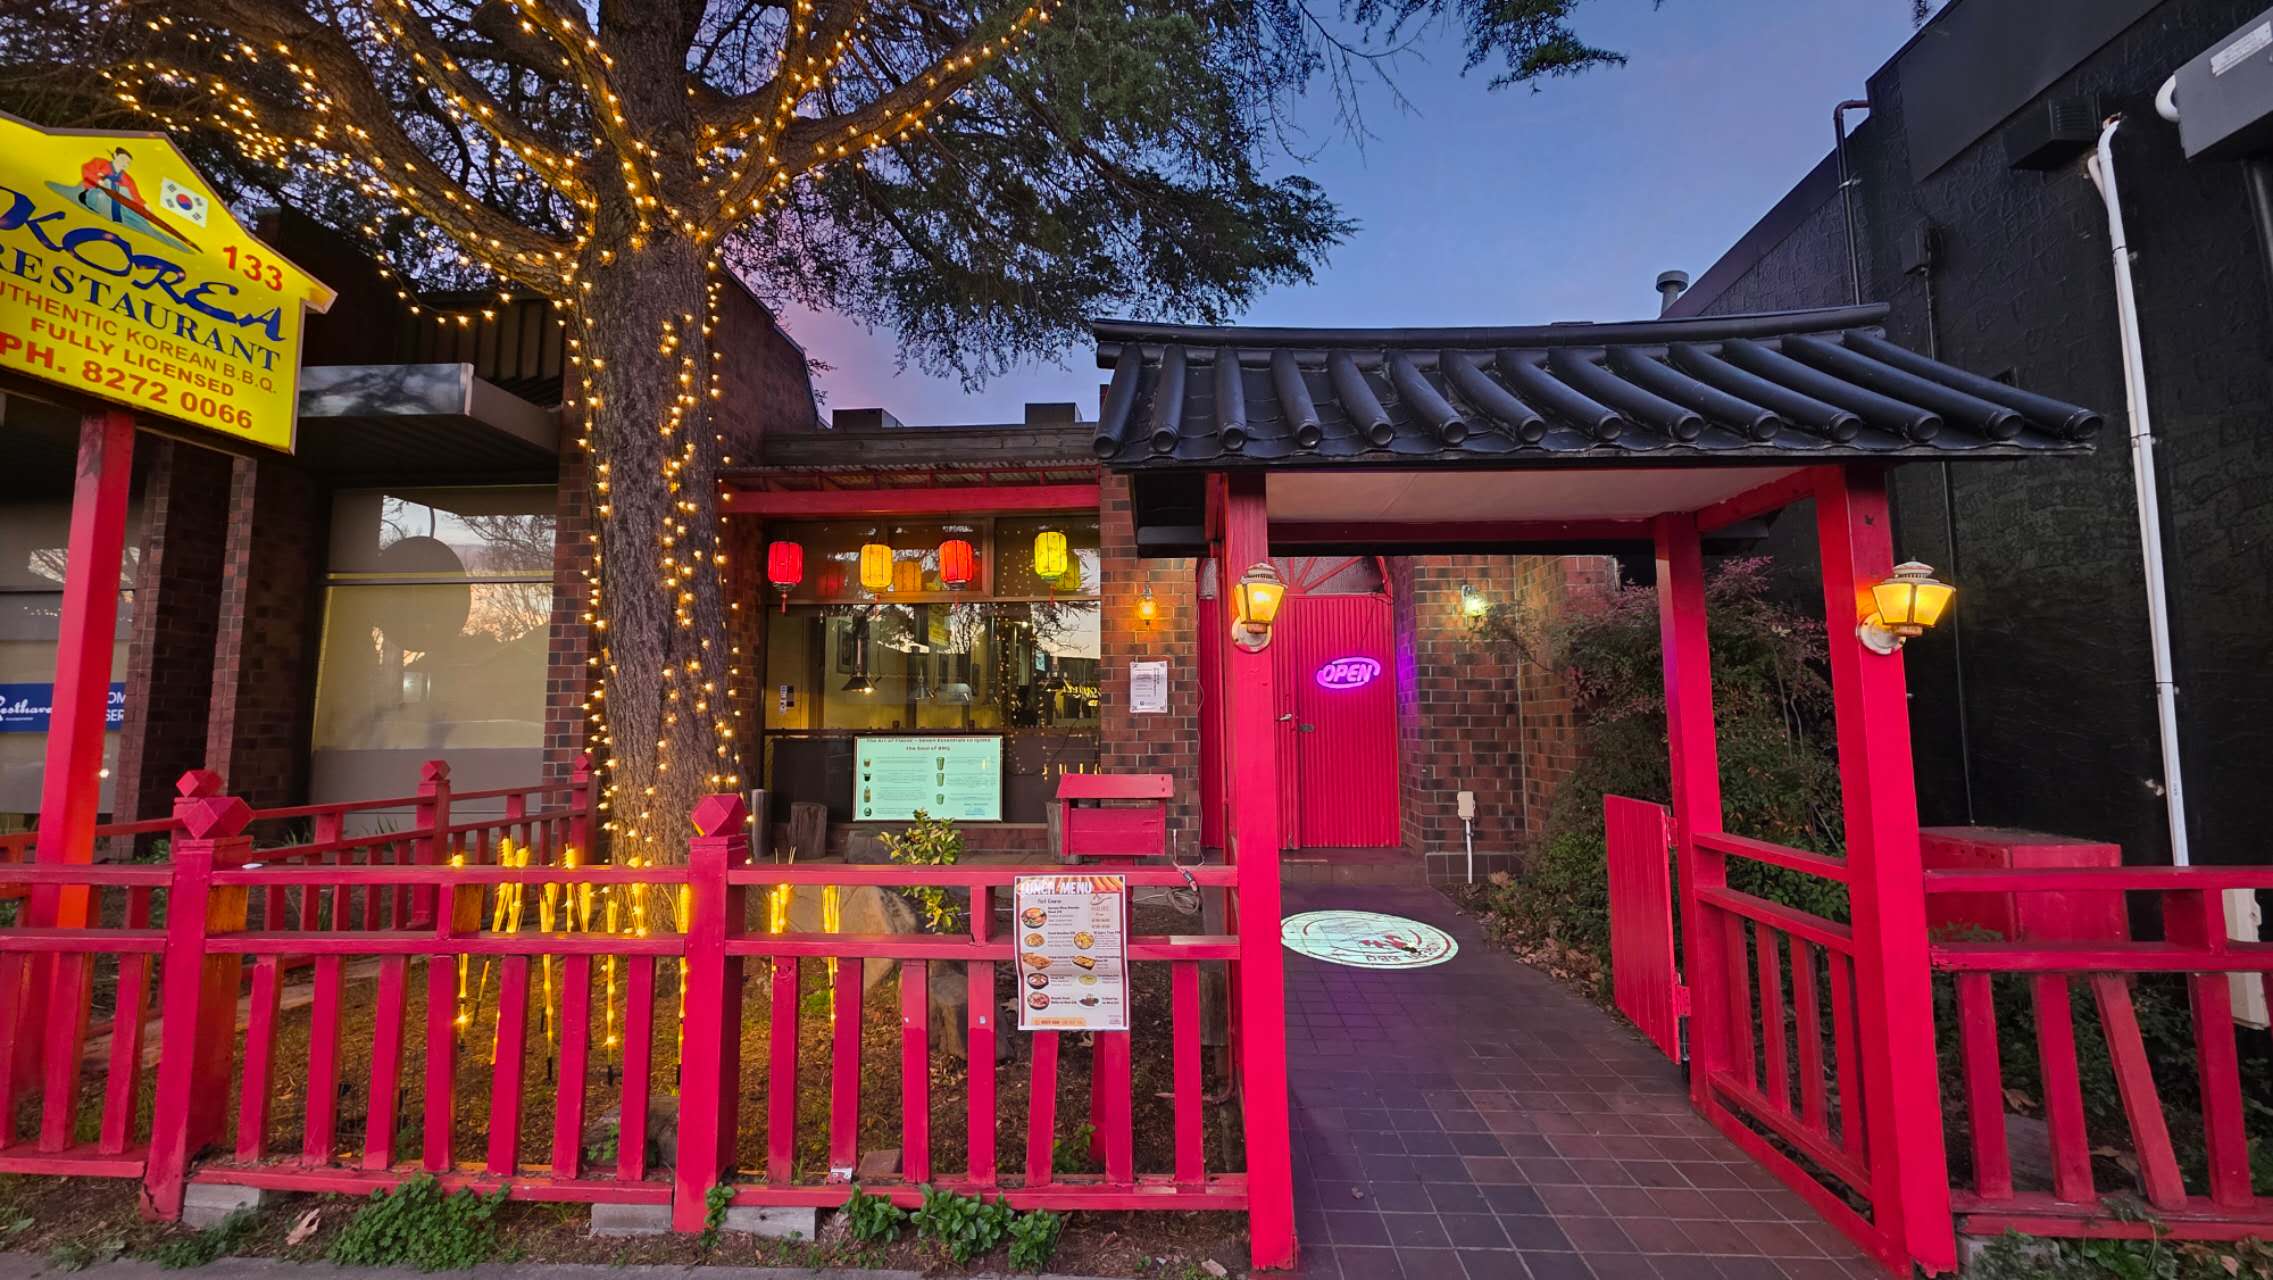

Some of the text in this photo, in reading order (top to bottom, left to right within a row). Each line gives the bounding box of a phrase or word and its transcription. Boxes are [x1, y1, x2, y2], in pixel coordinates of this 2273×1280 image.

[222, 244, 284, 292] 133
[0, 331, 253, 430] PH. 8272 0066
[31, 316, 235, 397] FULLY LICENSED
[126, 327, 217, 370] KOREAN
[224, 362, 278, 395] B.B.Q.
[1323, 664, 1373, 682] OPEN
[1059, 880, 1092, 895] MENU
